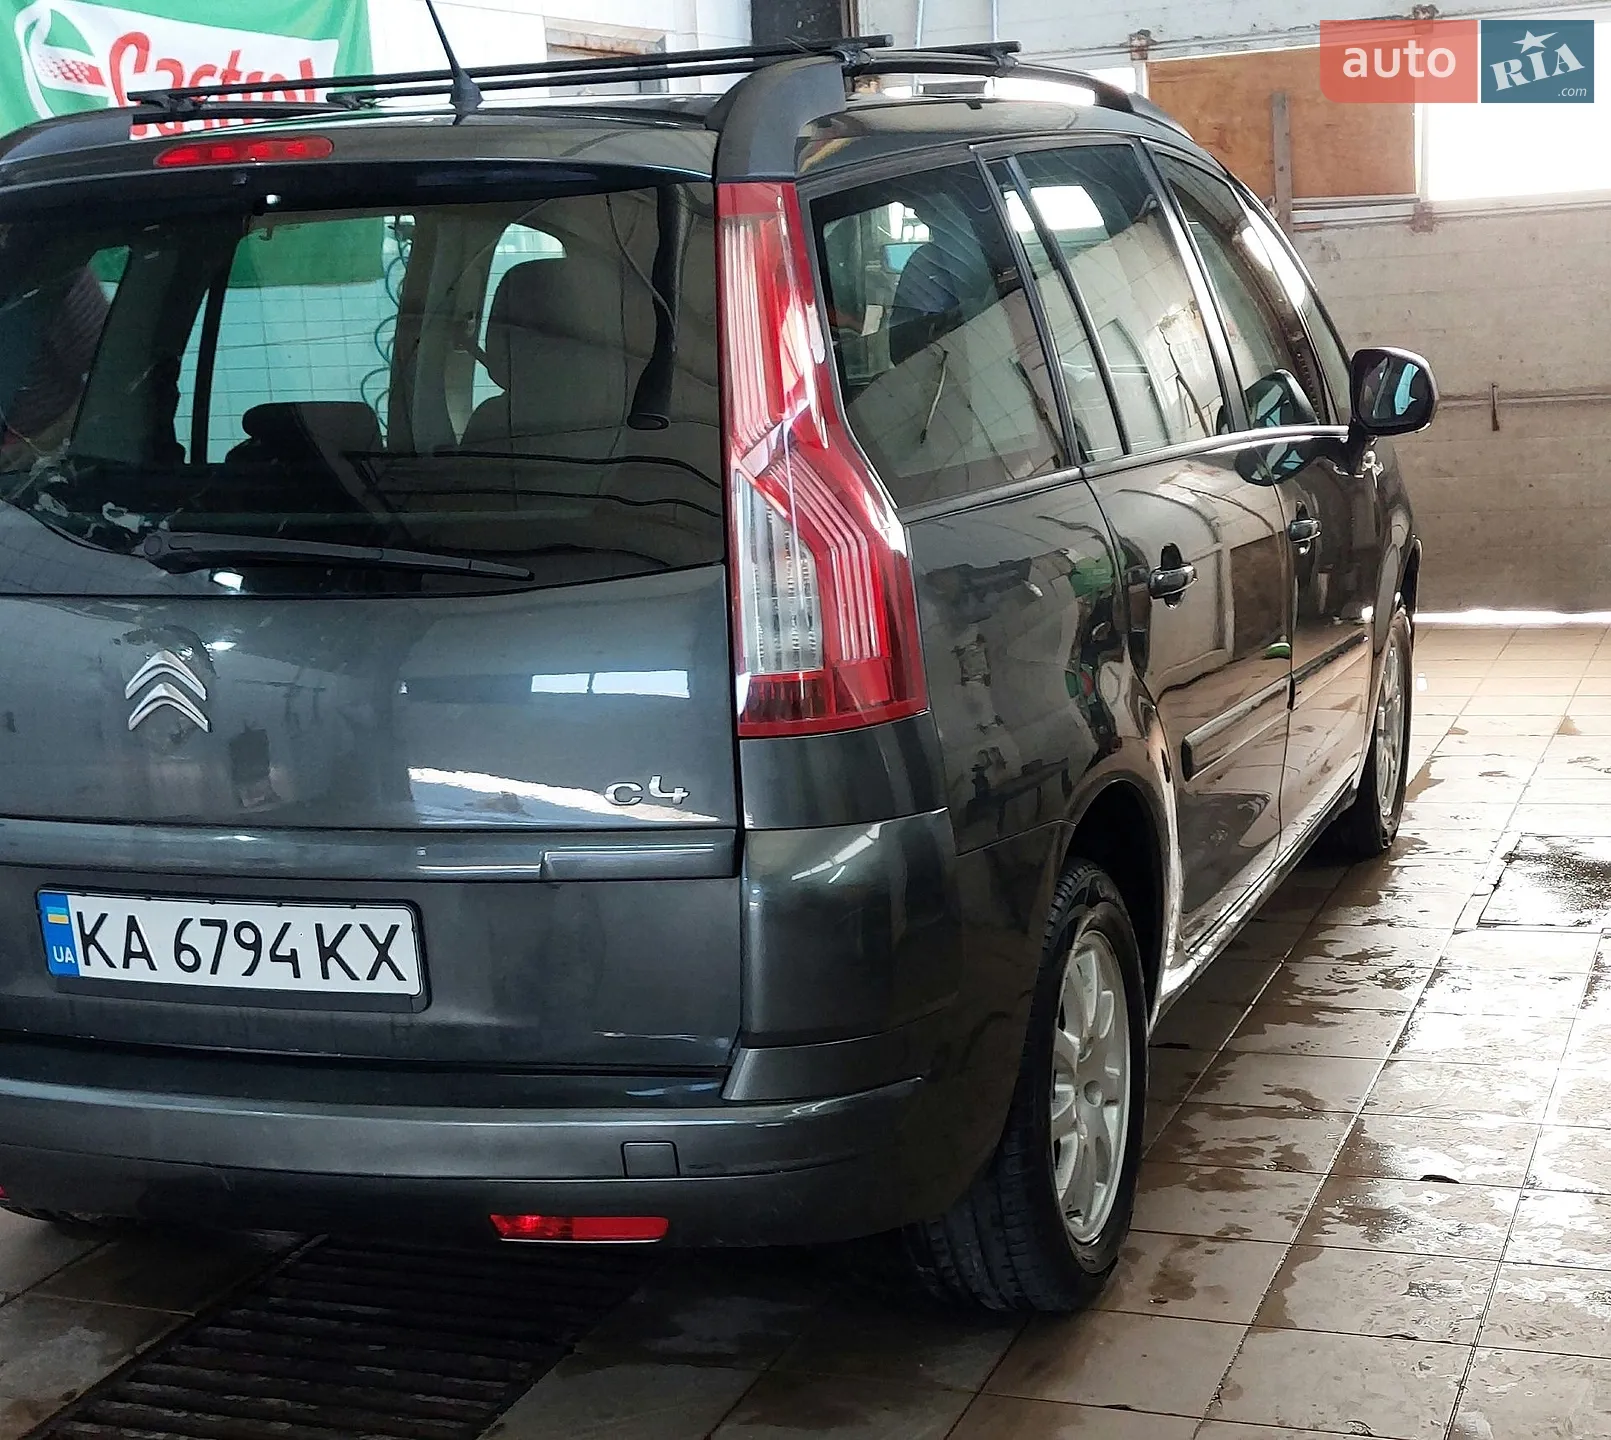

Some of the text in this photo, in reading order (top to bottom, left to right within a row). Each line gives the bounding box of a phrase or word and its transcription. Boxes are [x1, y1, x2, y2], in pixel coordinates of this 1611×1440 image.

[52, 945, 76, 964] UA
[76, 911, 407, 982] KA 6794 KX
